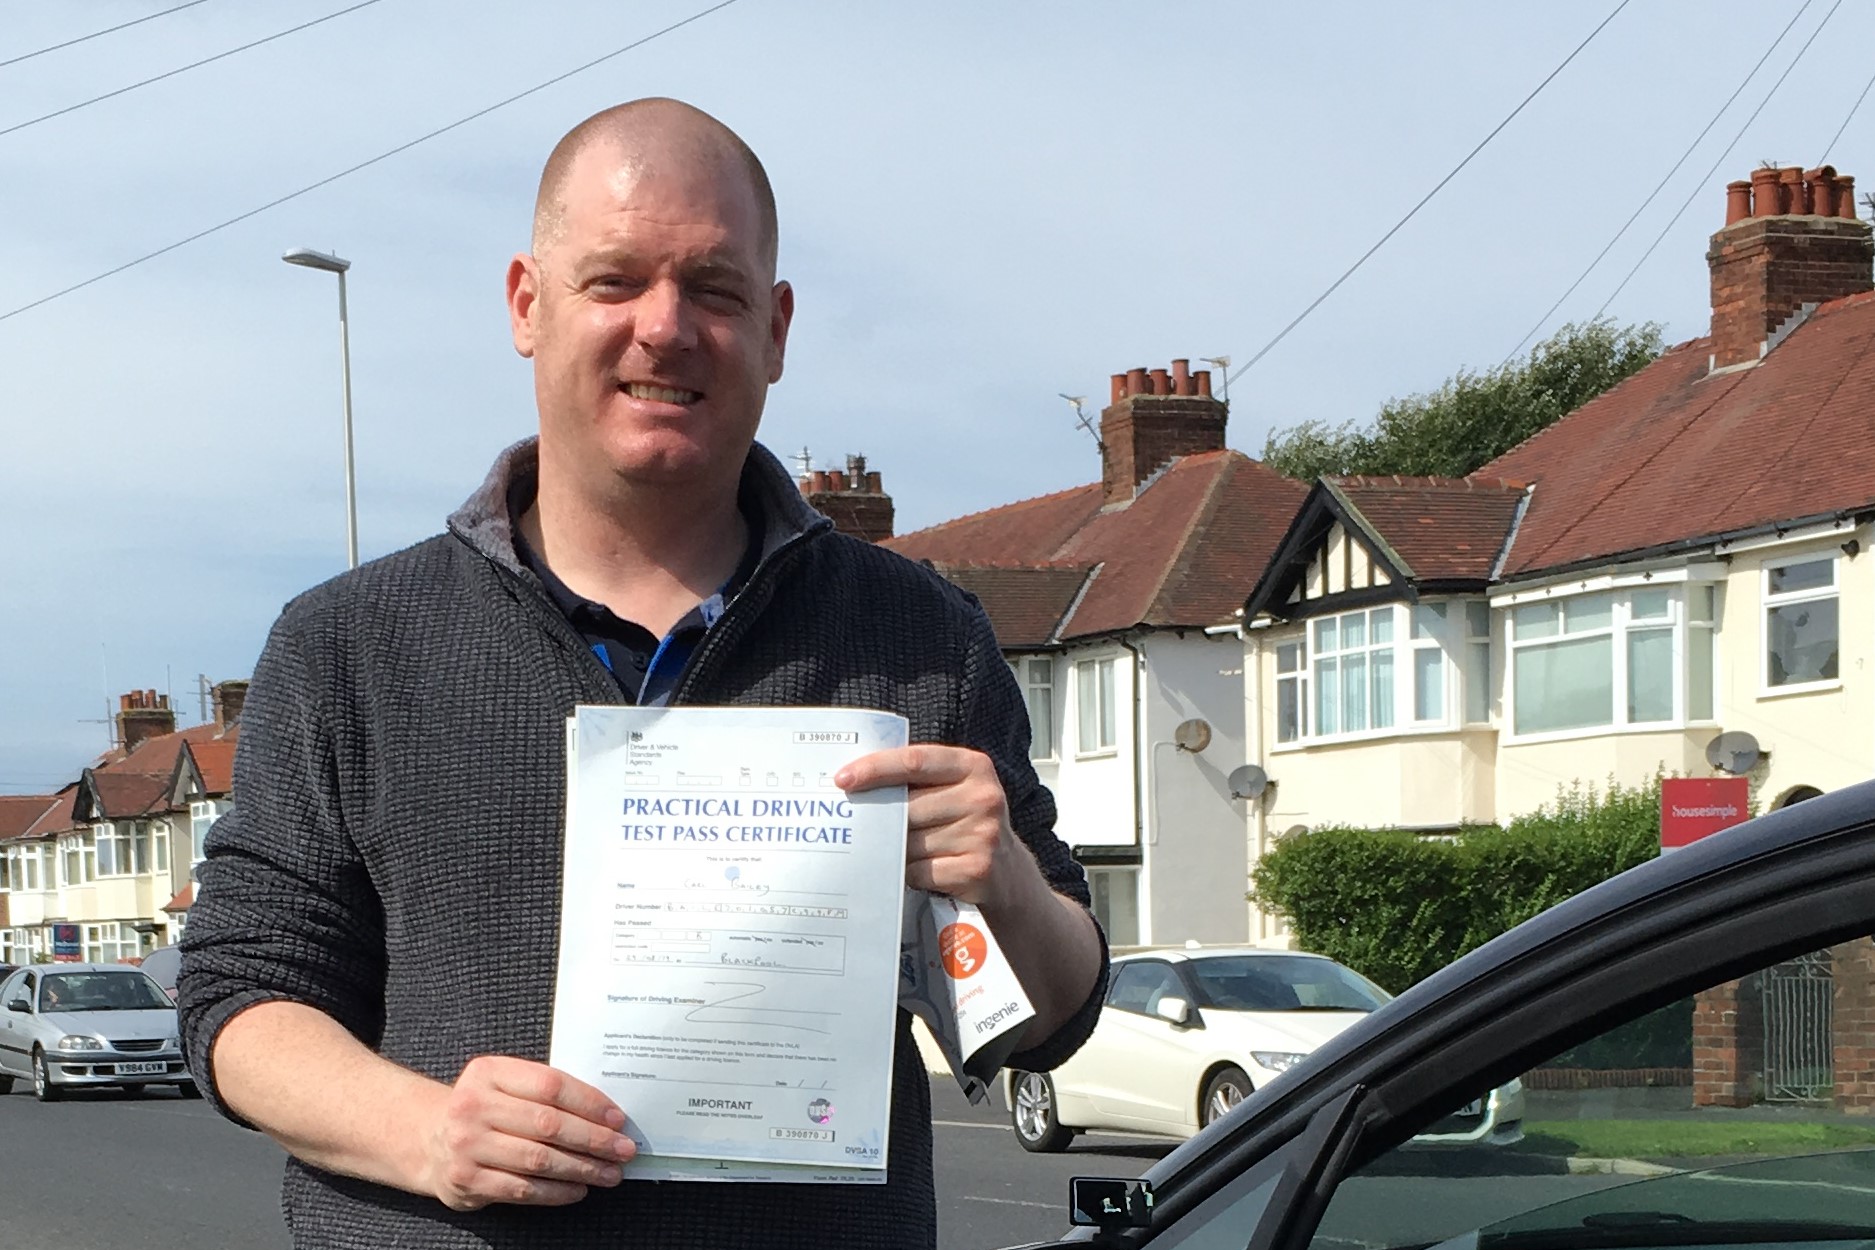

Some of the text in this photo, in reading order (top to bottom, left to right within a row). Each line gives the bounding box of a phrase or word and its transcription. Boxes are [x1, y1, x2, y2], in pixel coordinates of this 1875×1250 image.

[809, 733, 842, 743] 390870
[629, 759, 653, 767] Agency
[623, 797, 853, 819] PRACTICAL DRIVING
[1672, 803, 1738, 820] housesimple
[622, 825, 852, 845] TEST PASS CERTIFICATE
[607, 994, 638, 1003] Signature
[648, 996, 672, 1004] Driving
[673, 997, 705, 1005] Examiner
[973, 1001, 1020, 1034] ingenie
[688, 1097, 752, 1111] IMPORTANT
[775, 1129, 783, 1138] B
[821, 1132, 828, 1140] J
[845, 1146, 879, 1156] DVSA 10
